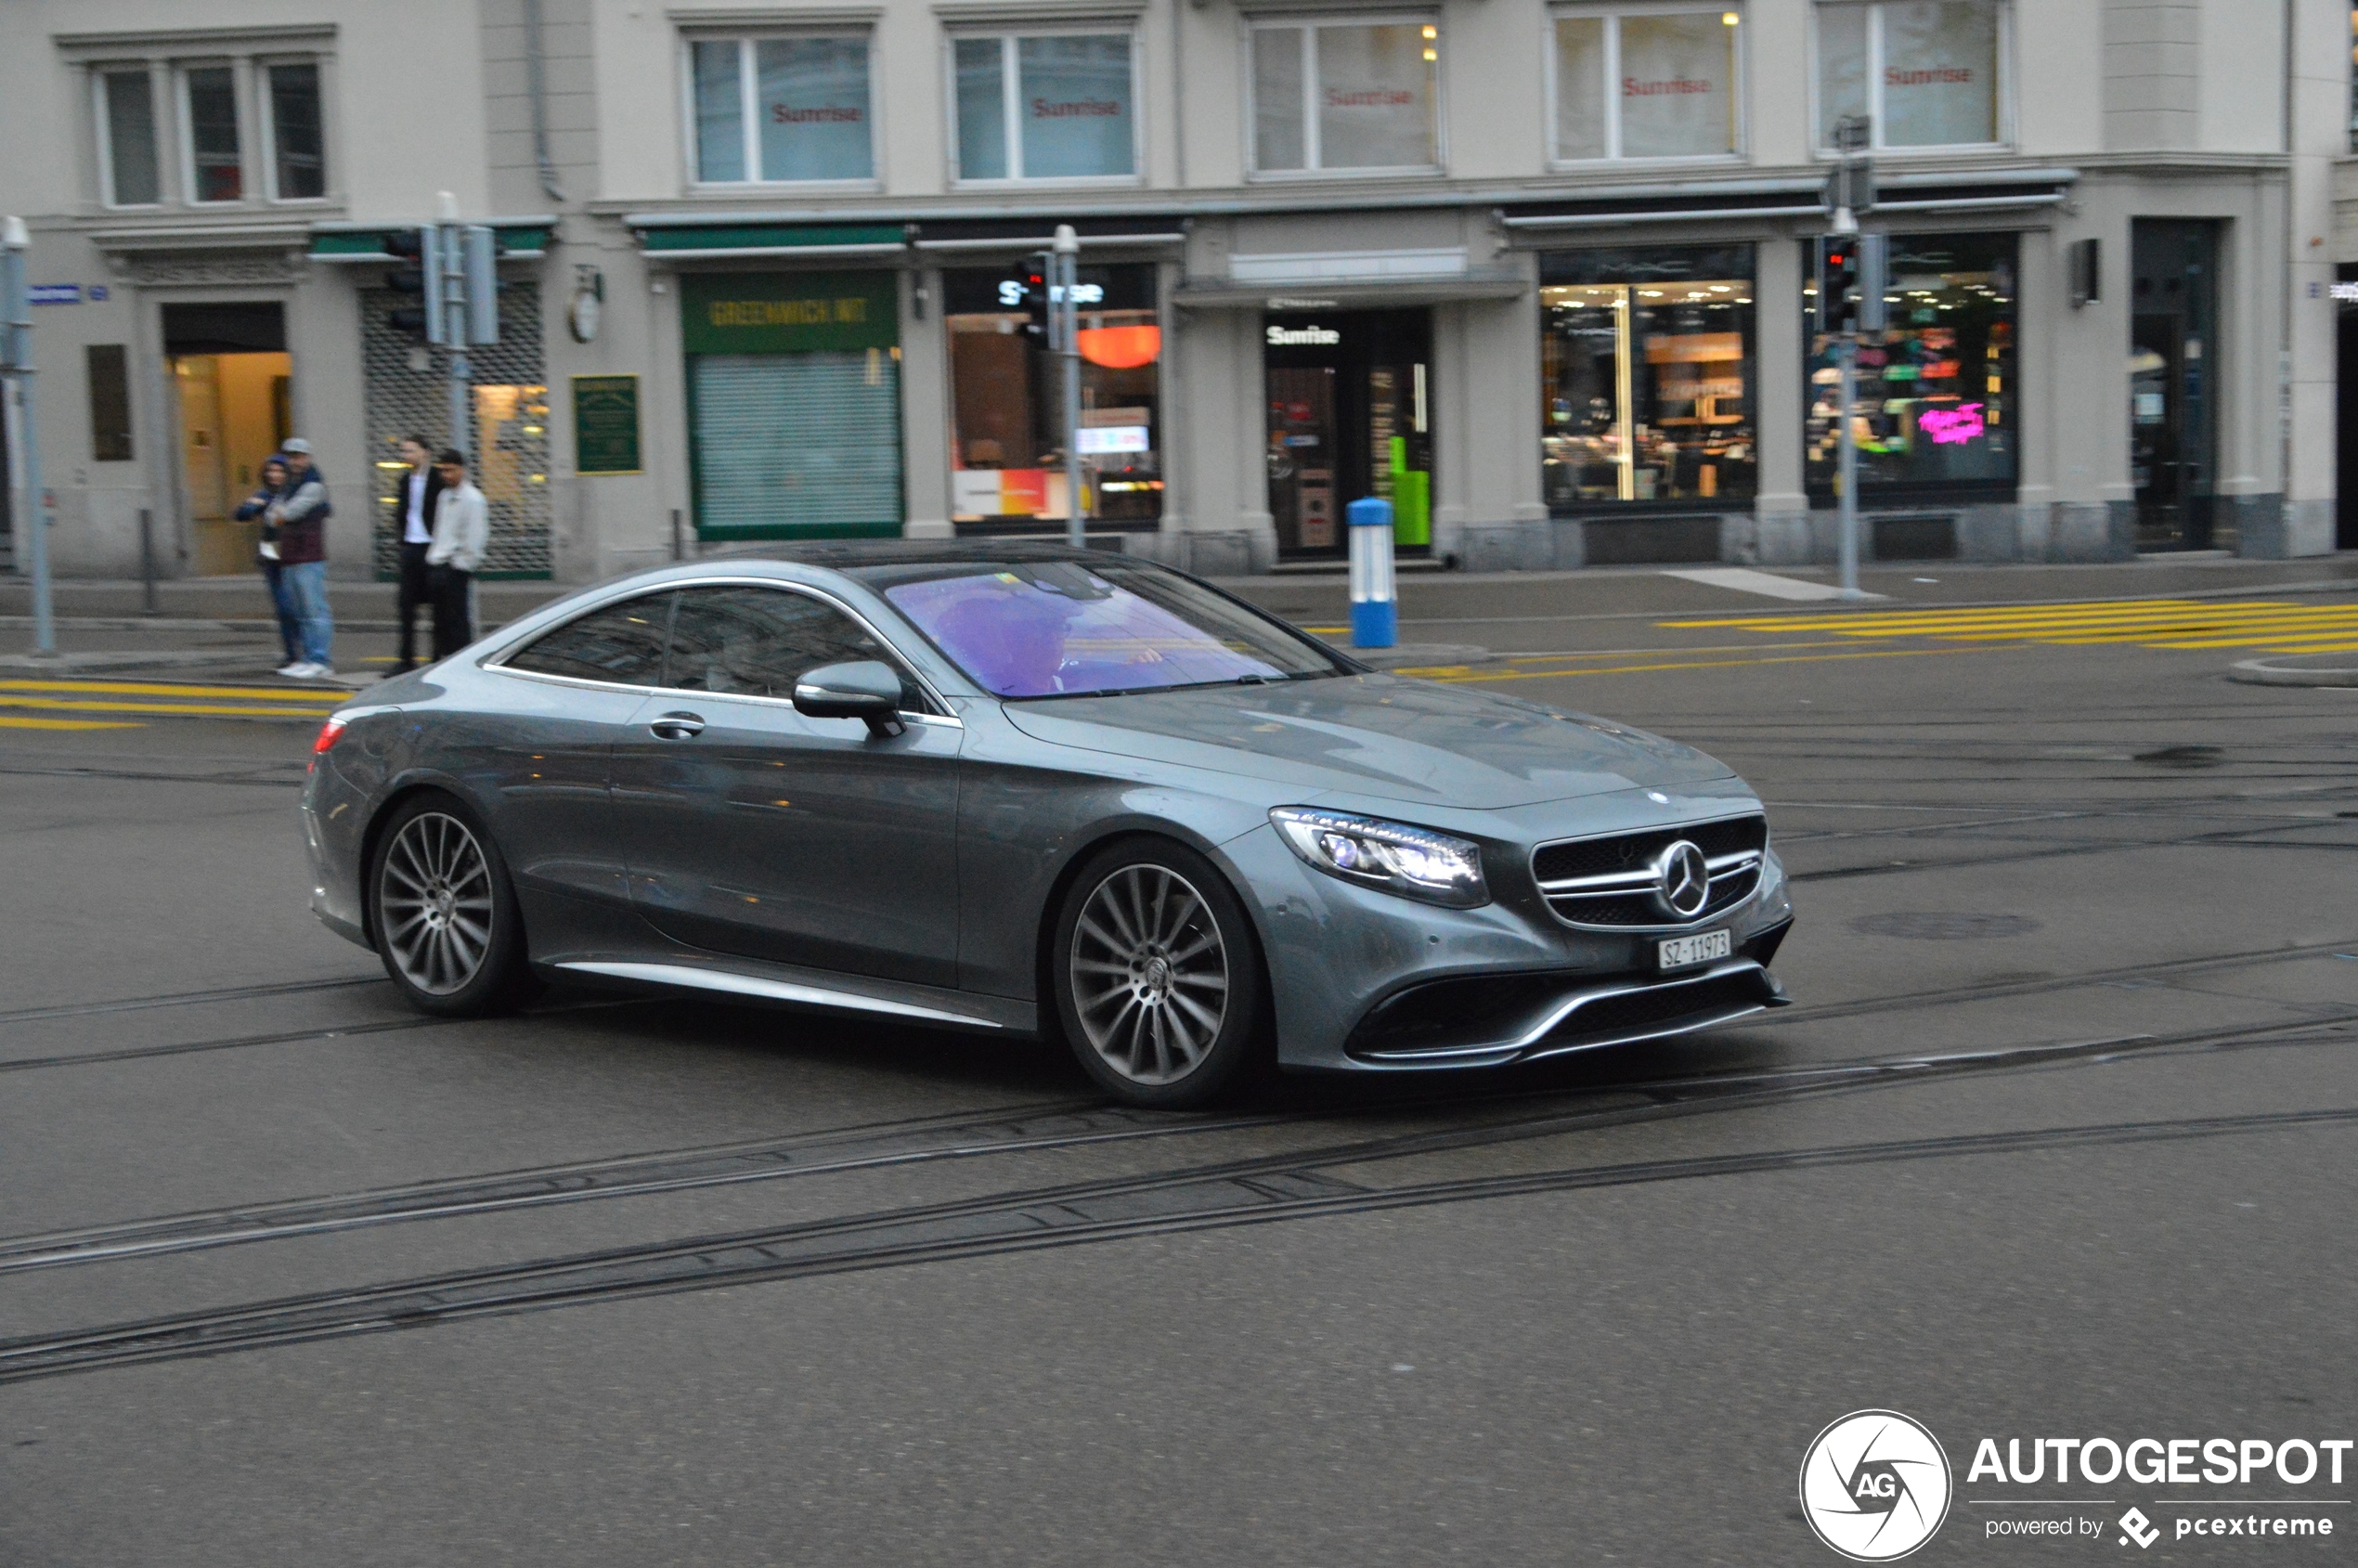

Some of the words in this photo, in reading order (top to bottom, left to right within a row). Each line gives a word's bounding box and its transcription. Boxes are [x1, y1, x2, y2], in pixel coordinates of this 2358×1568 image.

[1885, 64, 1972, 85] Sunrise
[1325, 85, 1412, 107] Sunrise
[1623, 74, 1711, 97] Sunrise
[771, 103, 862, 123] Sunrise
[1030, 97, 1121, 118] Sunrise
[1266, 325, 1341, 345] Sunrise
